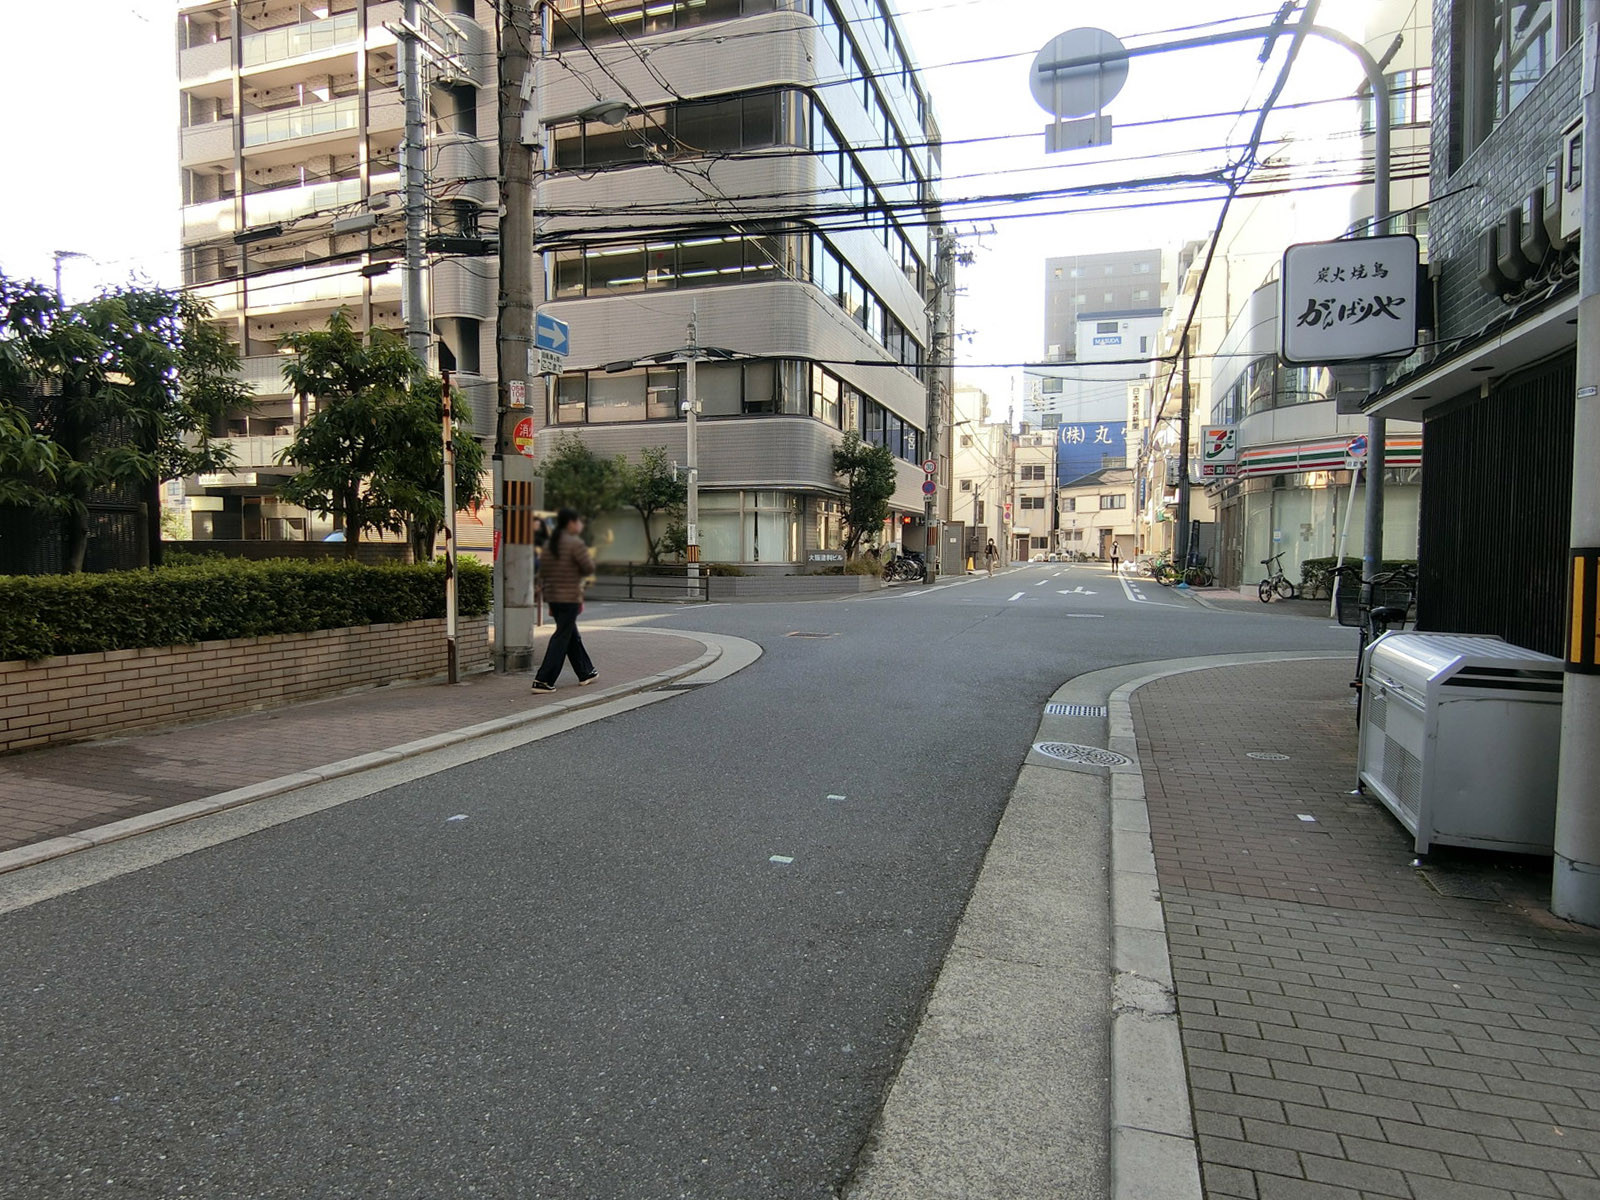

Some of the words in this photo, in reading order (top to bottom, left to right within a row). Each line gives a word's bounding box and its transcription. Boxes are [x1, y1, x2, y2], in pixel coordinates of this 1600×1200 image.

[1314, 262, 1388, 284] 炭火焼鳥
[1296, 296, 1405, 330] がんばりや
